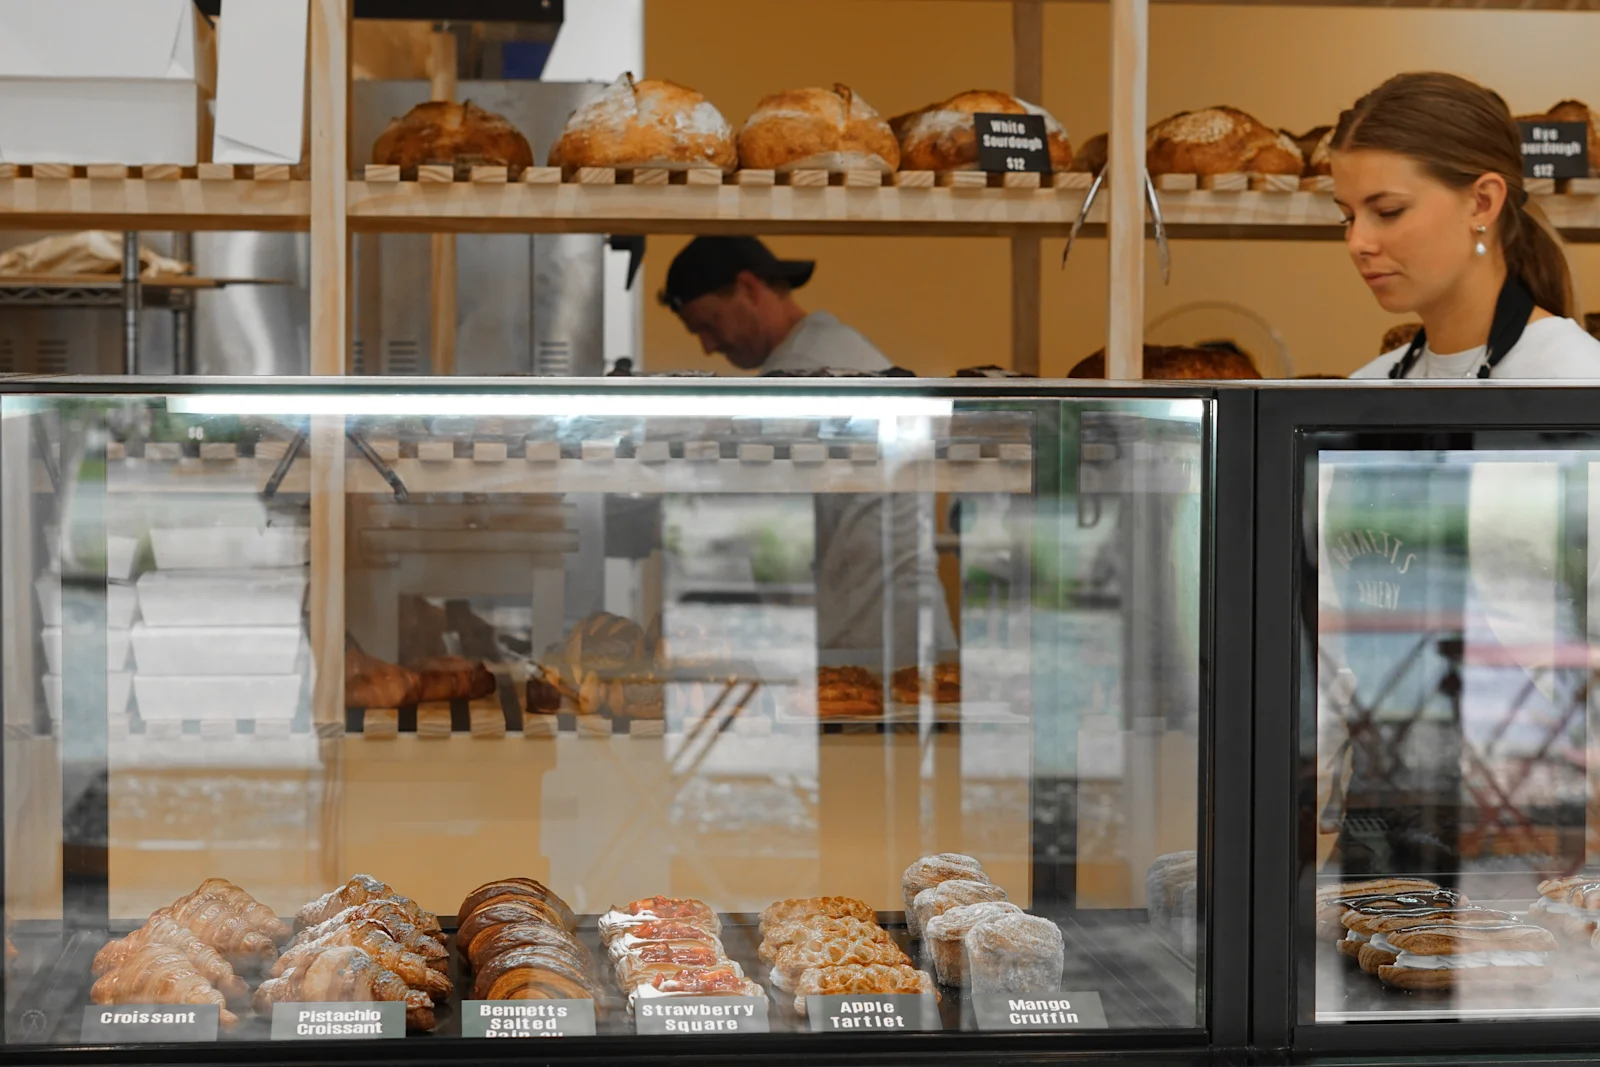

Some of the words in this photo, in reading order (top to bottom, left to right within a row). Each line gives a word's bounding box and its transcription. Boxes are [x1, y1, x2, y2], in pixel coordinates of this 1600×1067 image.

[990, 119, 1026, 135] White
[982, 133, 1043, 152] Sourdough
[1520, 140, 1582, 158] ourdough
[1006, 156, 1026, 171] $12
[479, 1004, 568, 1018] Bennetts
[642, 1003, 754, 1017] Strawberry
[840, 1000, 894, 1014] Apple
[1008, 998, 1071, 1012] Mango
[100, 1011, 196, 1024] Croissant
[298, 1009, 381, 1023] Pistachio
[830, 1015, 905, 1029] Tartlet
[1008, 1010, 1079, 1025] Cruffin
[296, 1021, 383, 1036] Croissant
[490, 1017, 557, 1030] Salted
[665, 1017, 738, 1033] Square
